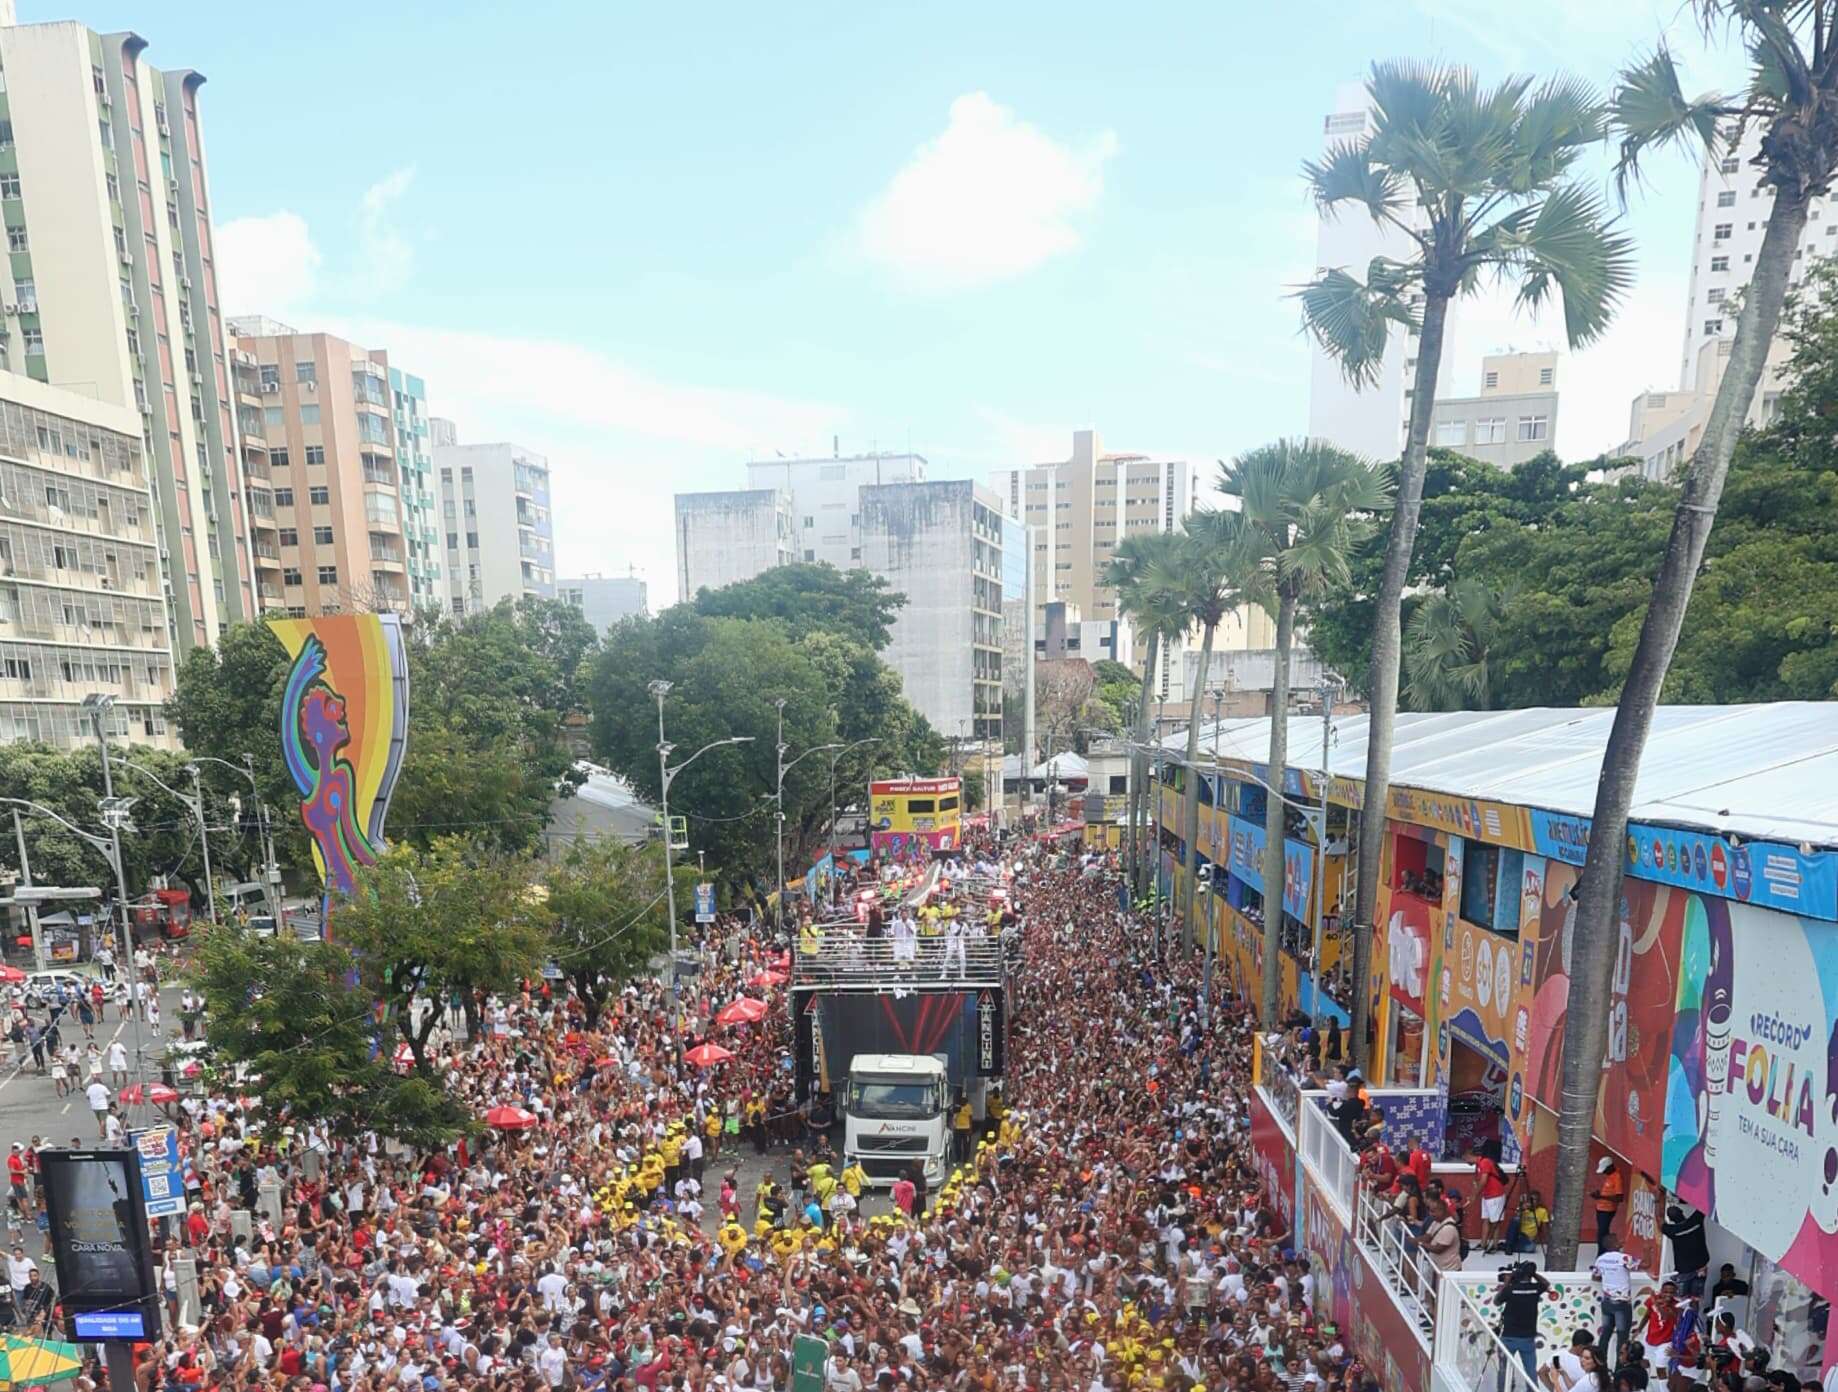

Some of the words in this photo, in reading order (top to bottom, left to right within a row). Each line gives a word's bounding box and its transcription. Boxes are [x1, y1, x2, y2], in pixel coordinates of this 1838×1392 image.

[1755, 1013, 1801, 1050] RECORD
[1726, 1038, 1814, 1138] FOLIA
[878, 1122, 917, 1135] AVANCINI
[1738, 1115, 1754, 1134] TEM
[1753, 1124, 1760, 1142] A
[1760, 1128, 1777, 1149] SUA
[1778, 1137, 1800, 1163] CARA
